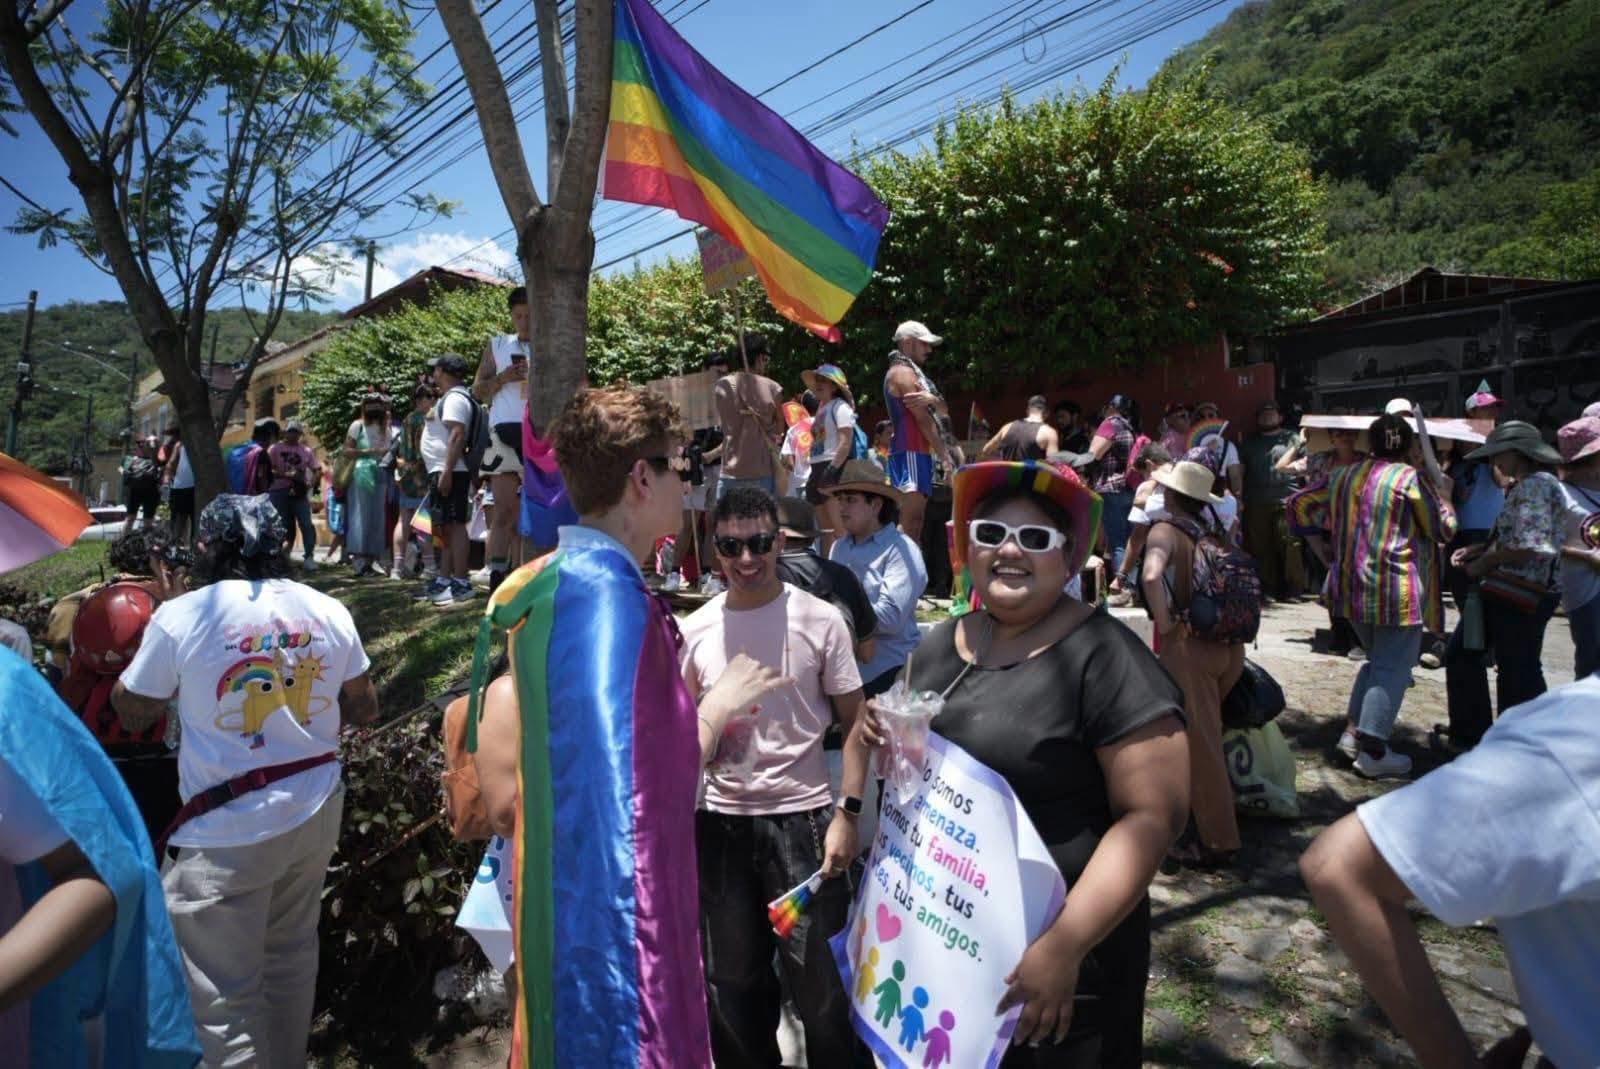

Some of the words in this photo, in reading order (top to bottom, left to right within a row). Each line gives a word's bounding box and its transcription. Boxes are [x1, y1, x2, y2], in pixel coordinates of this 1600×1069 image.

[913, 794, 981, 853] amenaza.
[931, 776, 974, 816] somos
[888, 842, 936, 898] vecinos,
[944, 884, 975, 920] tus
[910, 823, 924, 848] tu
[926, 835, 990, 897] familia,
[893, 879, 914, 911] tus
[916, 905, 983, 962] amigos.
